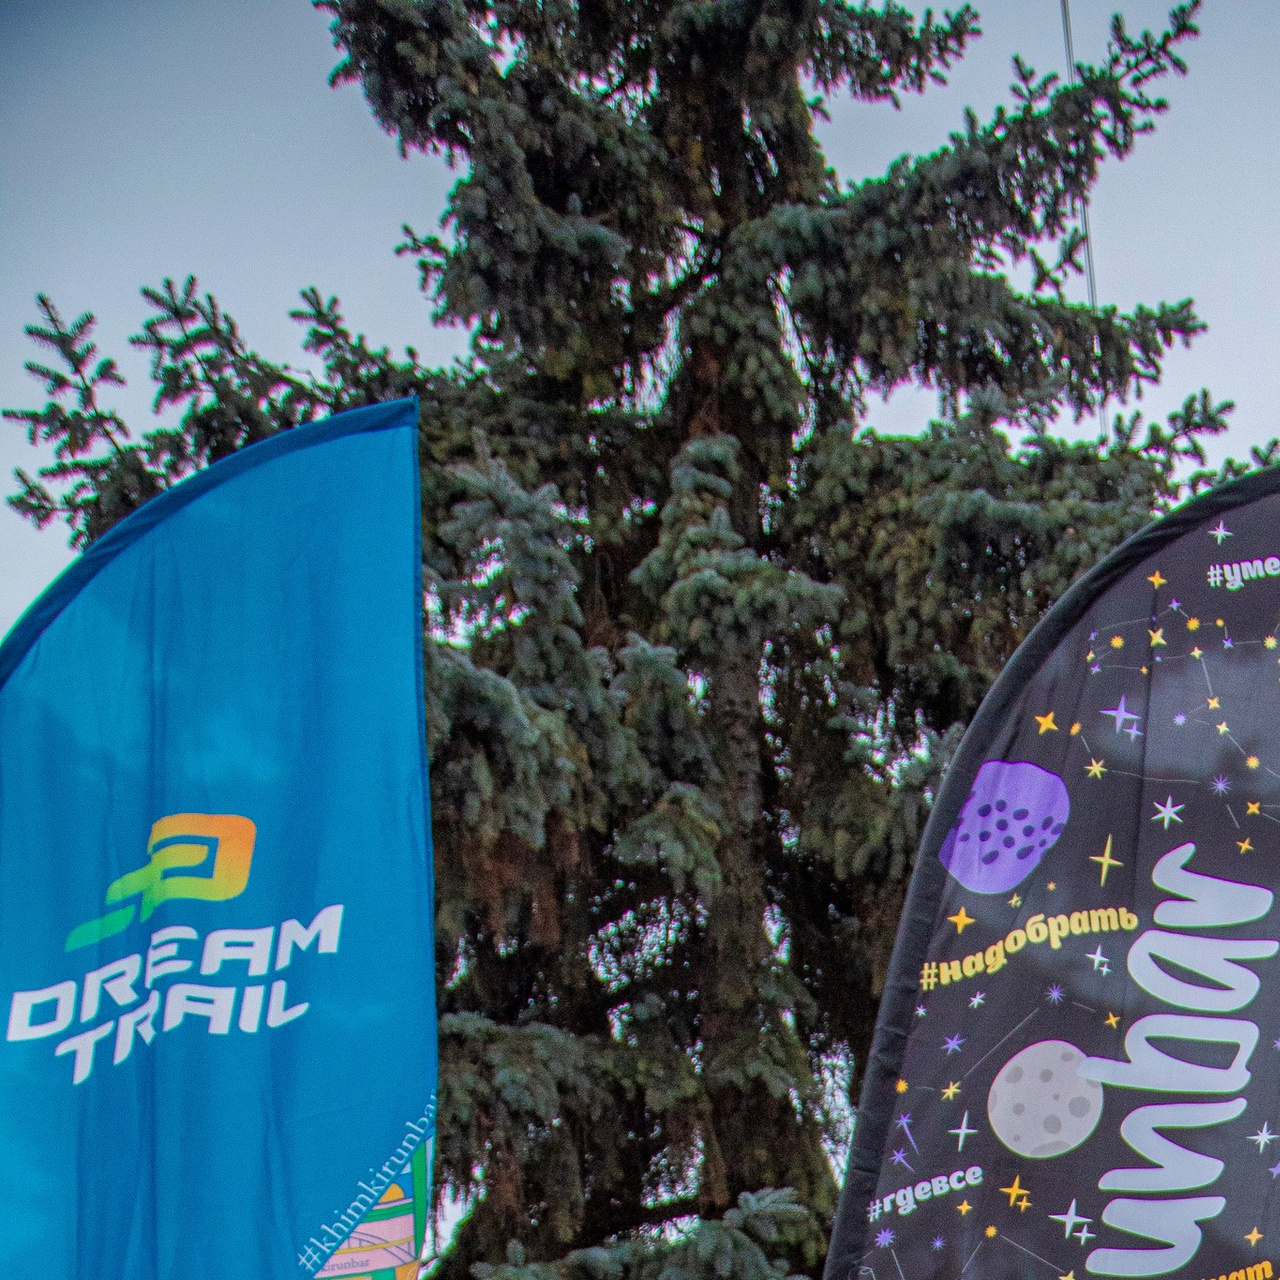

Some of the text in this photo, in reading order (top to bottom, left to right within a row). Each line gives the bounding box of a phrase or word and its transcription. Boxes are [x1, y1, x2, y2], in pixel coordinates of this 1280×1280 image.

[6, 904, 344, 1042] DREAM
[919, 906, 1139, 990] #надобрать
[55, 979, 310, 1085] TRAIL
[866, 1164, 984, 1223] #гдевсе
